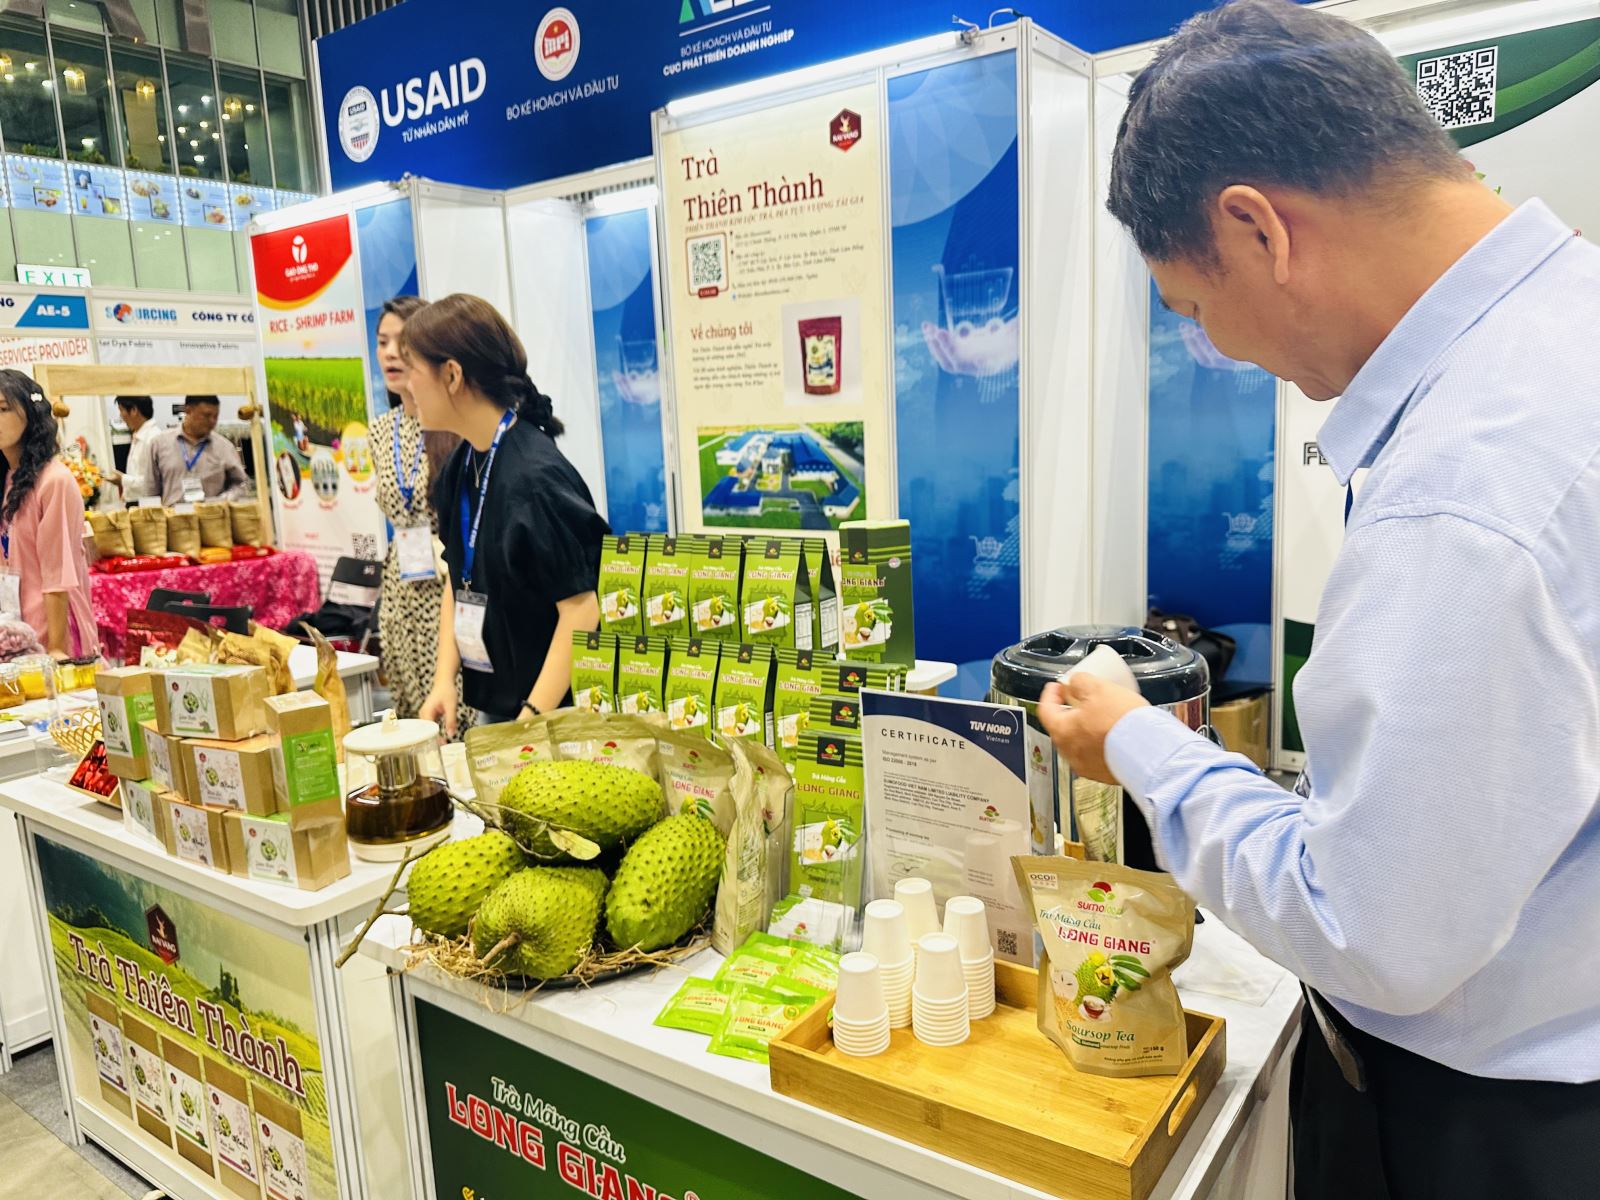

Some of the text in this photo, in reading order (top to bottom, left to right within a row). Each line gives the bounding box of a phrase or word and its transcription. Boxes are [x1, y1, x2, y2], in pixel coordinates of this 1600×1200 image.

[726, 40, 759, 58] DOANH
[381, 57, 487, 127] USAID
[681, 148, 719, 181] Trà
[683, 173, 824, 222] Thiên Thành
[24, 270, 84, 287] EXIT
[192, 311, 223, 322] CÔNG
[226, 313, 238, 321] TY
[269, 319, 288, 333] RICE
[296, 313, 328, 331] SHRIMP
[330, 309, 355, 326] FARM
[39, 337, 88, 360] PROVIDER
[860, 578, 885, 587] GIANG
[881, 728, 966, 749] CERTIFICATE
[986, 723, 1011, 735] NORD
[986, 735, 1010, 744] Vietnam
[797, 783, 860, 799] LONG GIANG
[1030, 873, 1056, 881] OCOP
[1058, 926, 1151, 954] LONG GIANG
[68, 931, 306, 1098] Trà Thiên Thành
[1066, 1020, 1135, 1042] Soursop Tea
[491, 1076, 626, 1163] Trà Mãng Cầu
[445, 1081, 677, 1200] LONG GIAN
